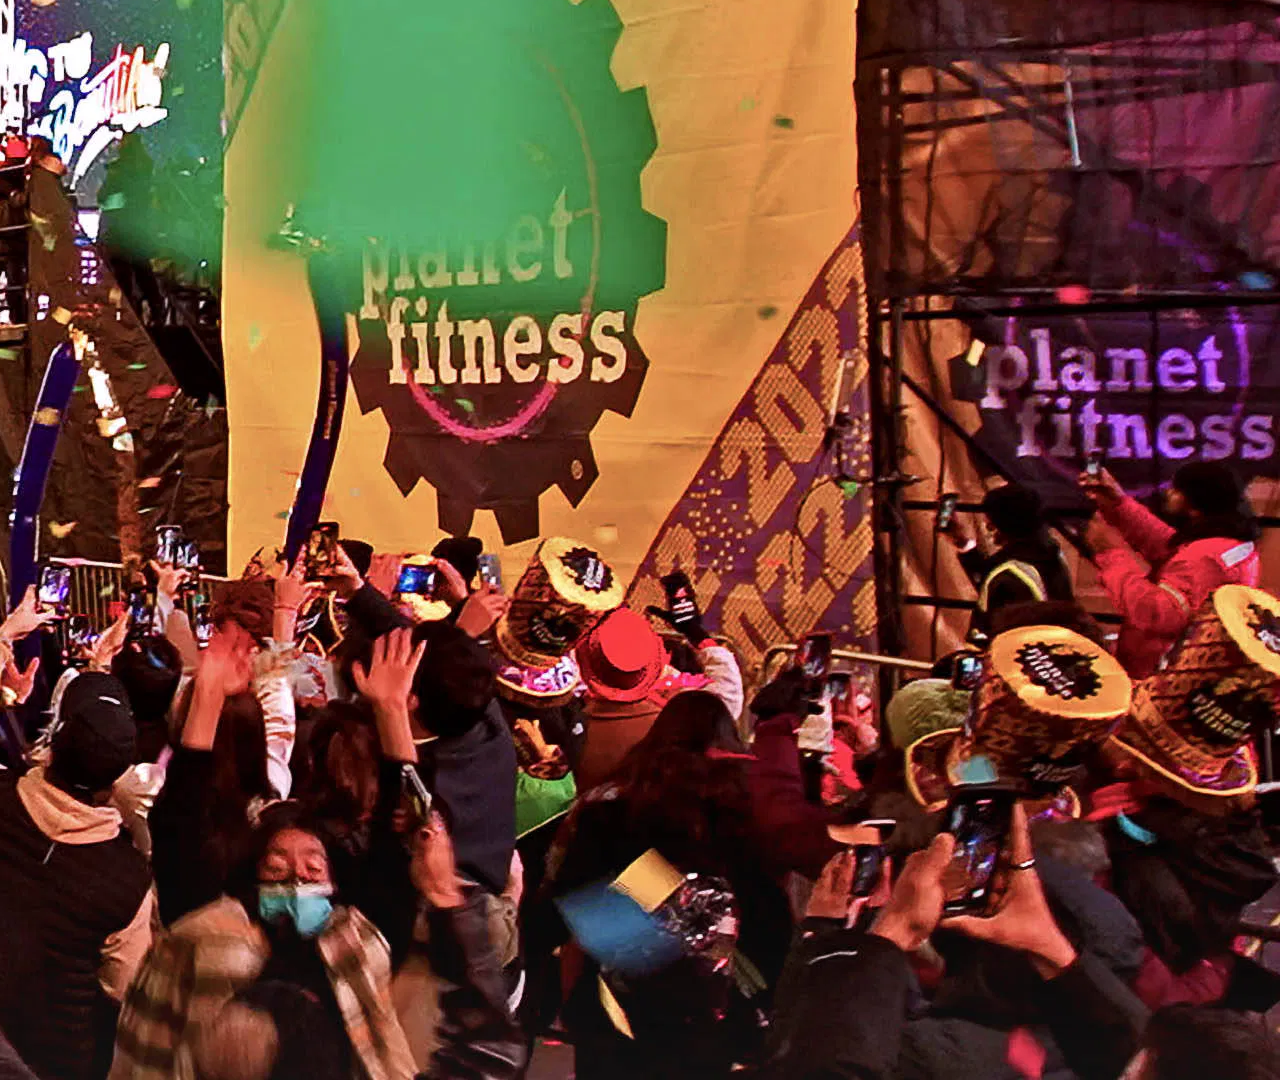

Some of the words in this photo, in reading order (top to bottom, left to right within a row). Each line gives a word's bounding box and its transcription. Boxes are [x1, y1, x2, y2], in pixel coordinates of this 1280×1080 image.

[387, 296, 627, 384] fitness
[980, 328, 1226, 409] planet
[1016, 395, 1275, 459] fitness
